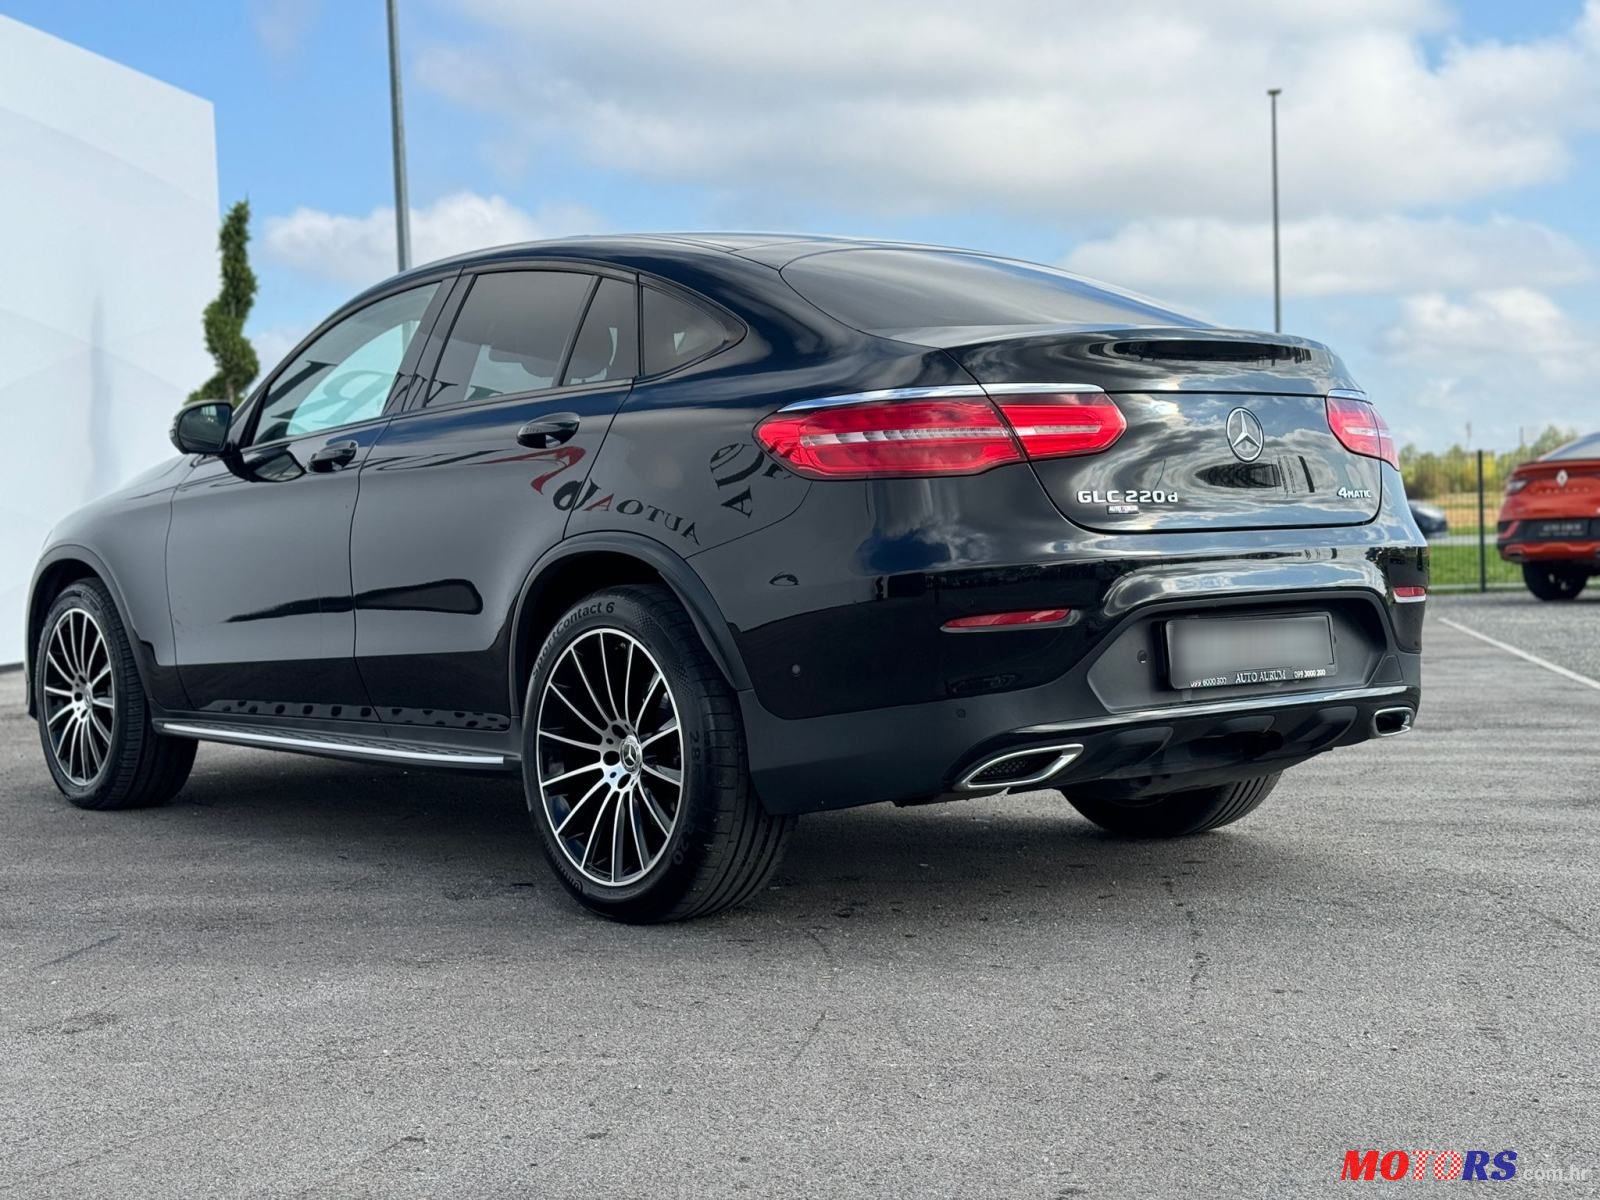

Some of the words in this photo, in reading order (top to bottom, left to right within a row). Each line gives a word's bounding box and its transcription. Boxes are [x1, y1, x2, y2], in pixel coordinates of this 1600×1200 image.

[1077, 490, 1120, 504] GLC
[1337, 487, 1371, 498] 4MATIC
[606, 600, 616, 613] 6
[1235, 672, 1258, 684] AUTO
[1259, 669, 1287, 682] AURUM
